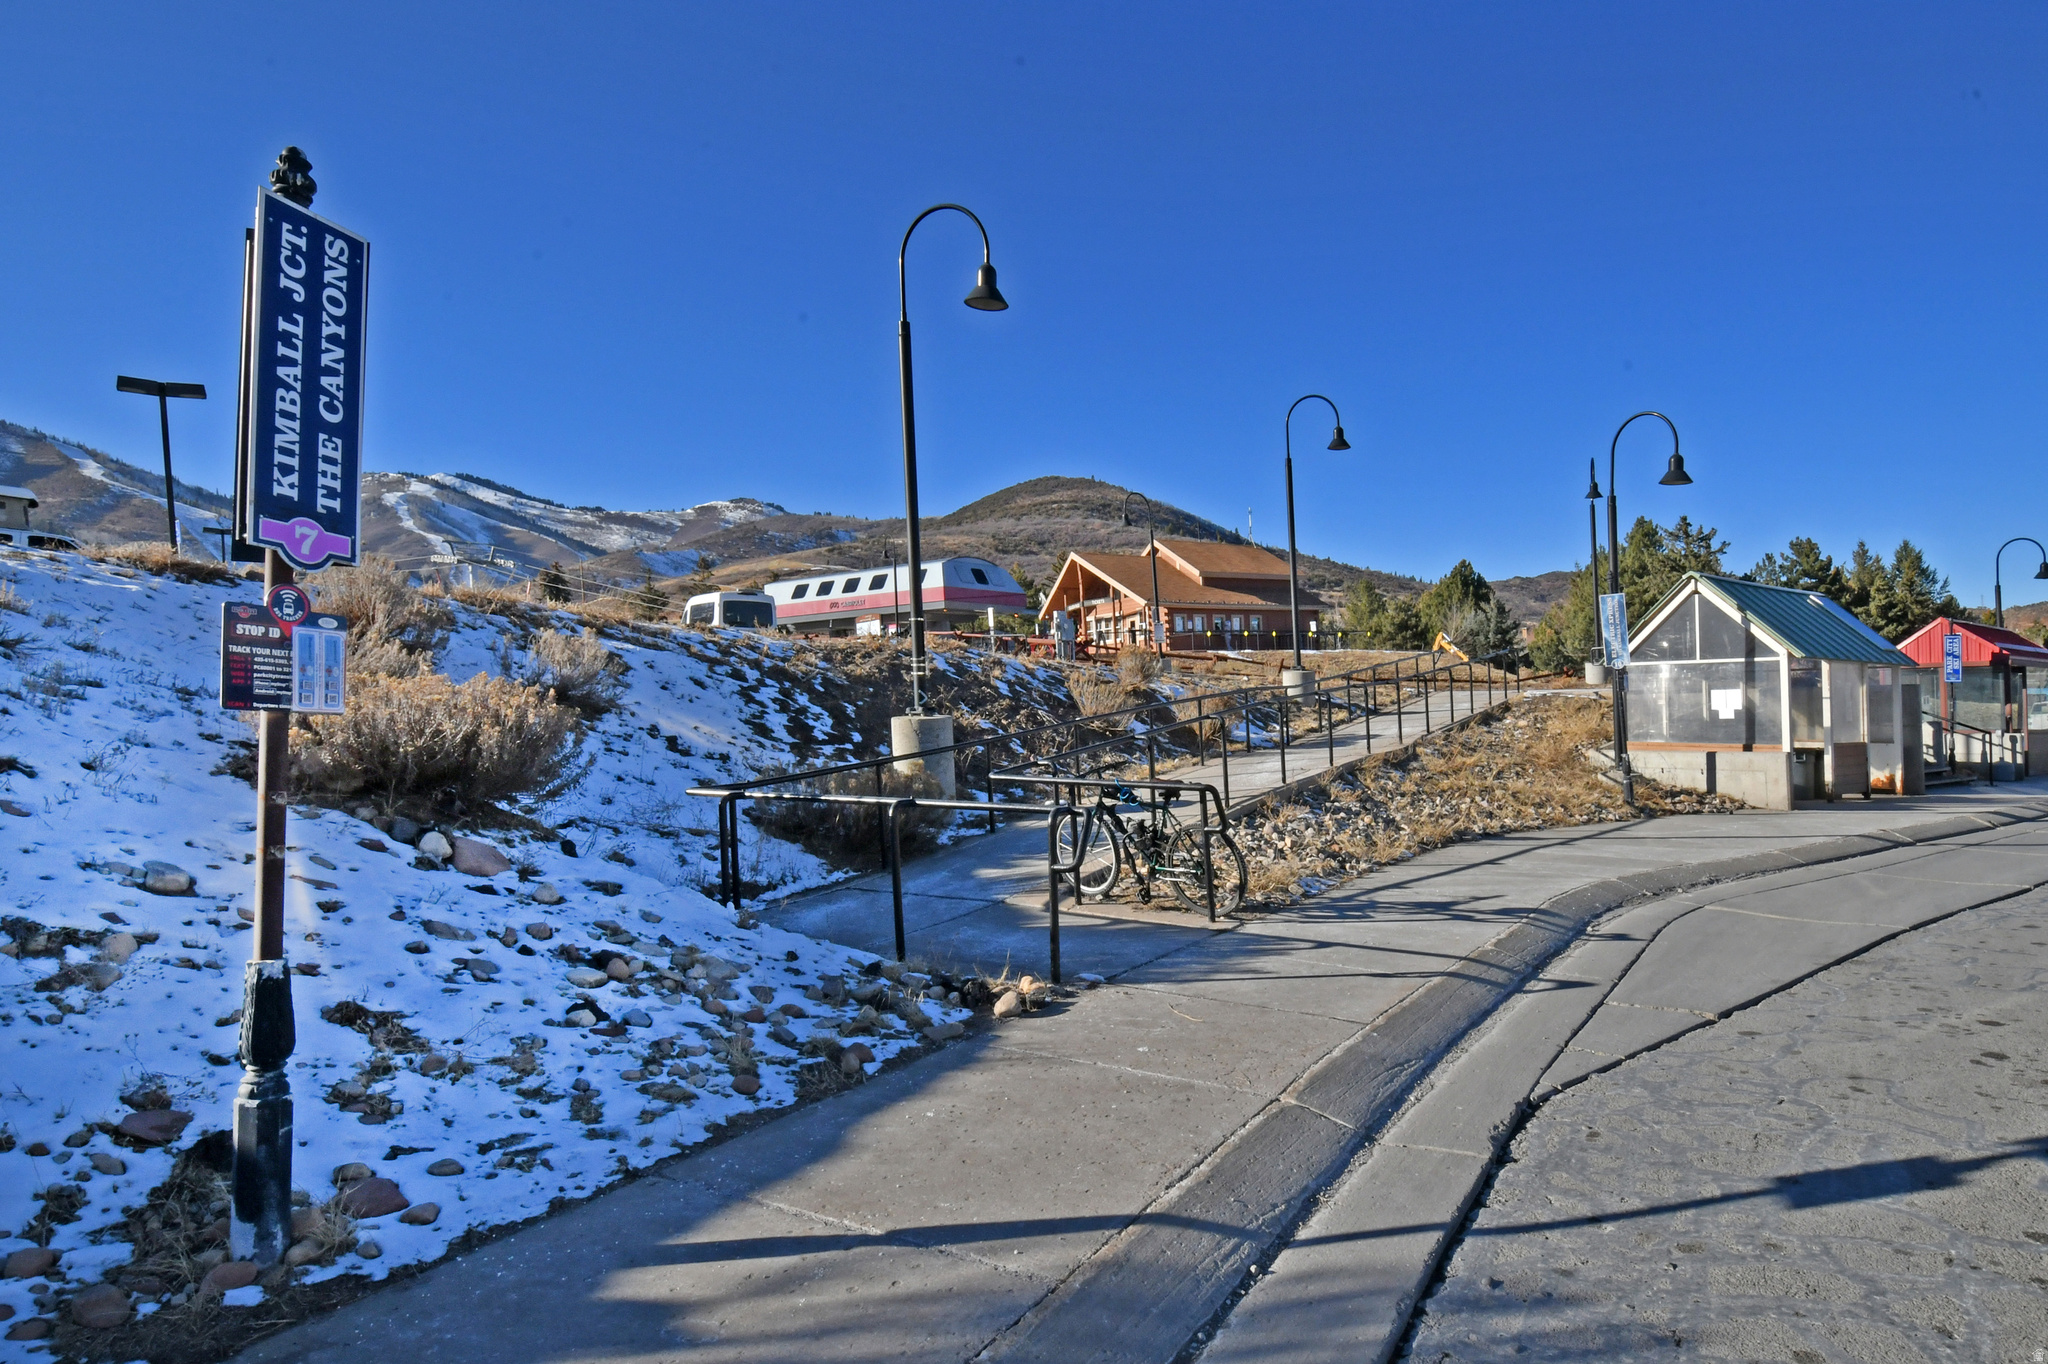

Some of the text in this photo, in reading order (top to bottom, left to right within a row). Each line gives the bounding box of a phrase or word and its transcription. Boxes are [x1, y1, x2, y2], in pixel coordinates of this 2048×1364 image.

[273, 221, 308, 502] KIMBALL JCT.
[317, 233, 349, 513] THE CANYONS
[294, 524, 319, 555] 7
[236, 623, 281, 638] STOP ID
[228, 645, 251, 654] TRACK
[252, 646, 271, 656] YOUR
[272, 648, 289, 657] NEXT
